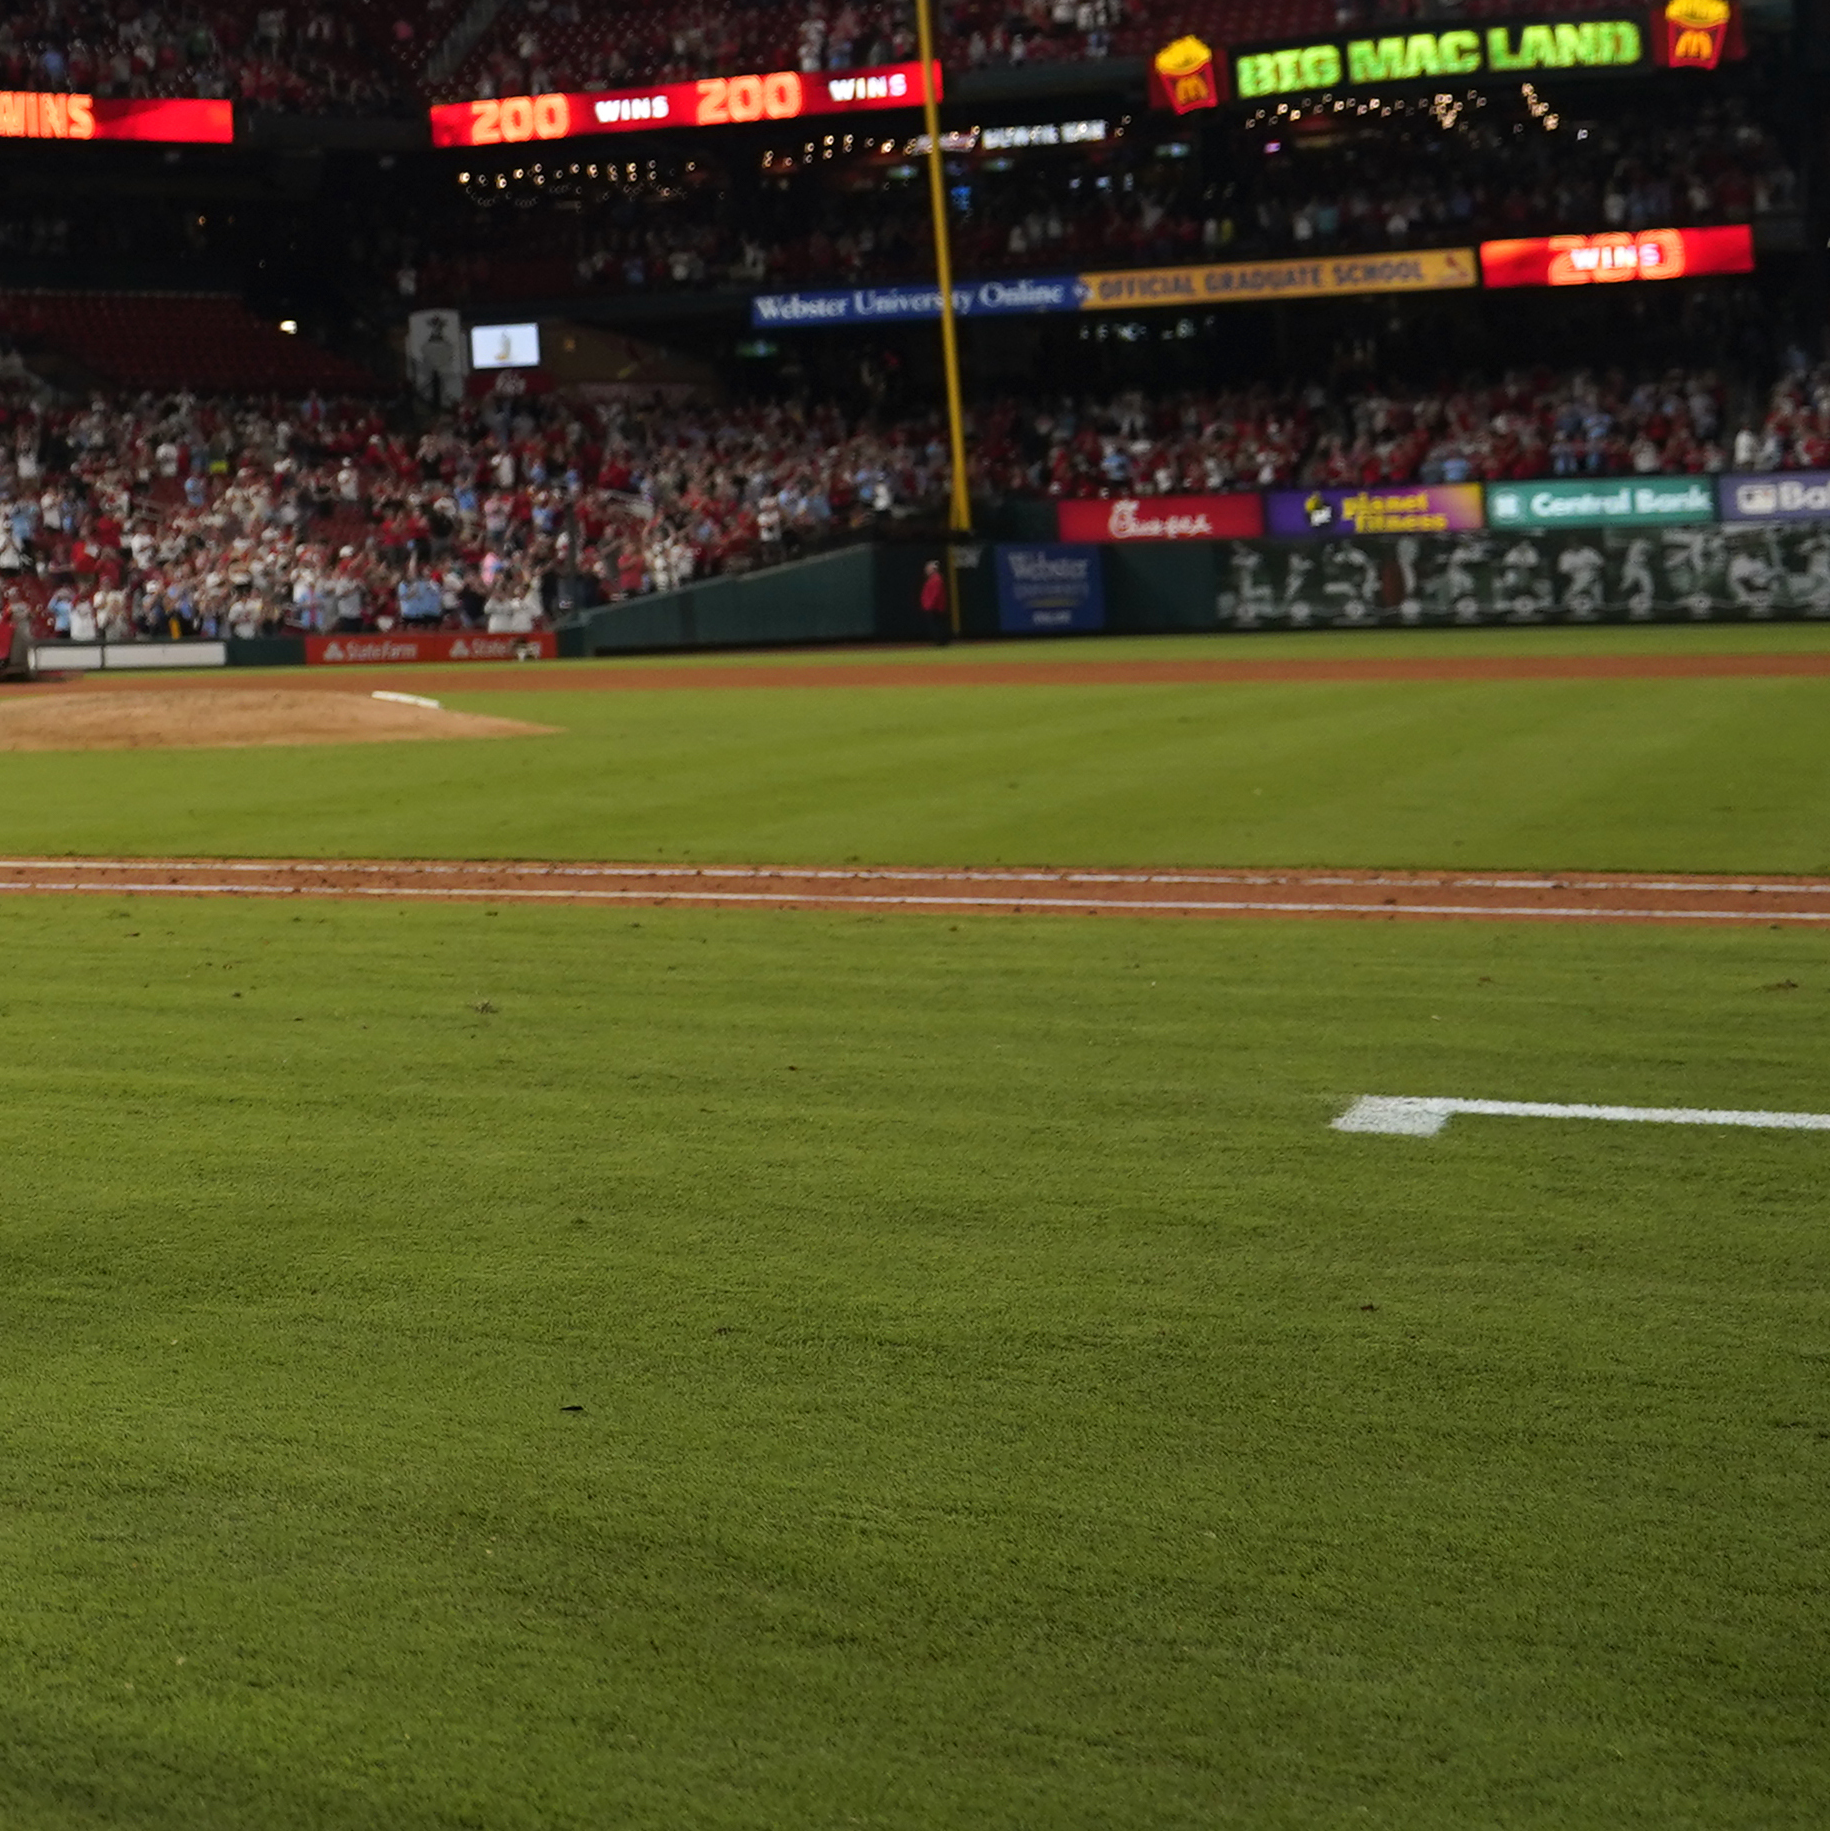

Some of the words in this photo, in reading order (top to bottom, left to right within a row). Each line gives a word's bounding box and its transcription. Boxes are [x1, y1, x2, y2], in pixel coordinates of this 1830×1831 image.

[1238, 45, 1340, 98] BIG
[1347, 30, 1481, 84] MAC
[1486, 20, 1640, 70] LAND
[470, 93, 570, 145] 200
[594, 95, 670, 123] WINS
[695, 71, 803, 126] 200
[828, 74, 907, 102] WINS
[1098, 275, 1195, 301] OFFICIAL
[1203, 265, 1321, 295] GRADUATE
[1332, 259, 1423, 285] SCHOOL
[757, 293, 849, 319] Webster
[853, 287, 976, 316] Universty
[1342, 491, 1429, 520] planet
[1530, 487, 1632, 517] Central
[1634, 483, 1713, 513] Bank
[1355, 513, 1449, 533] fitness
